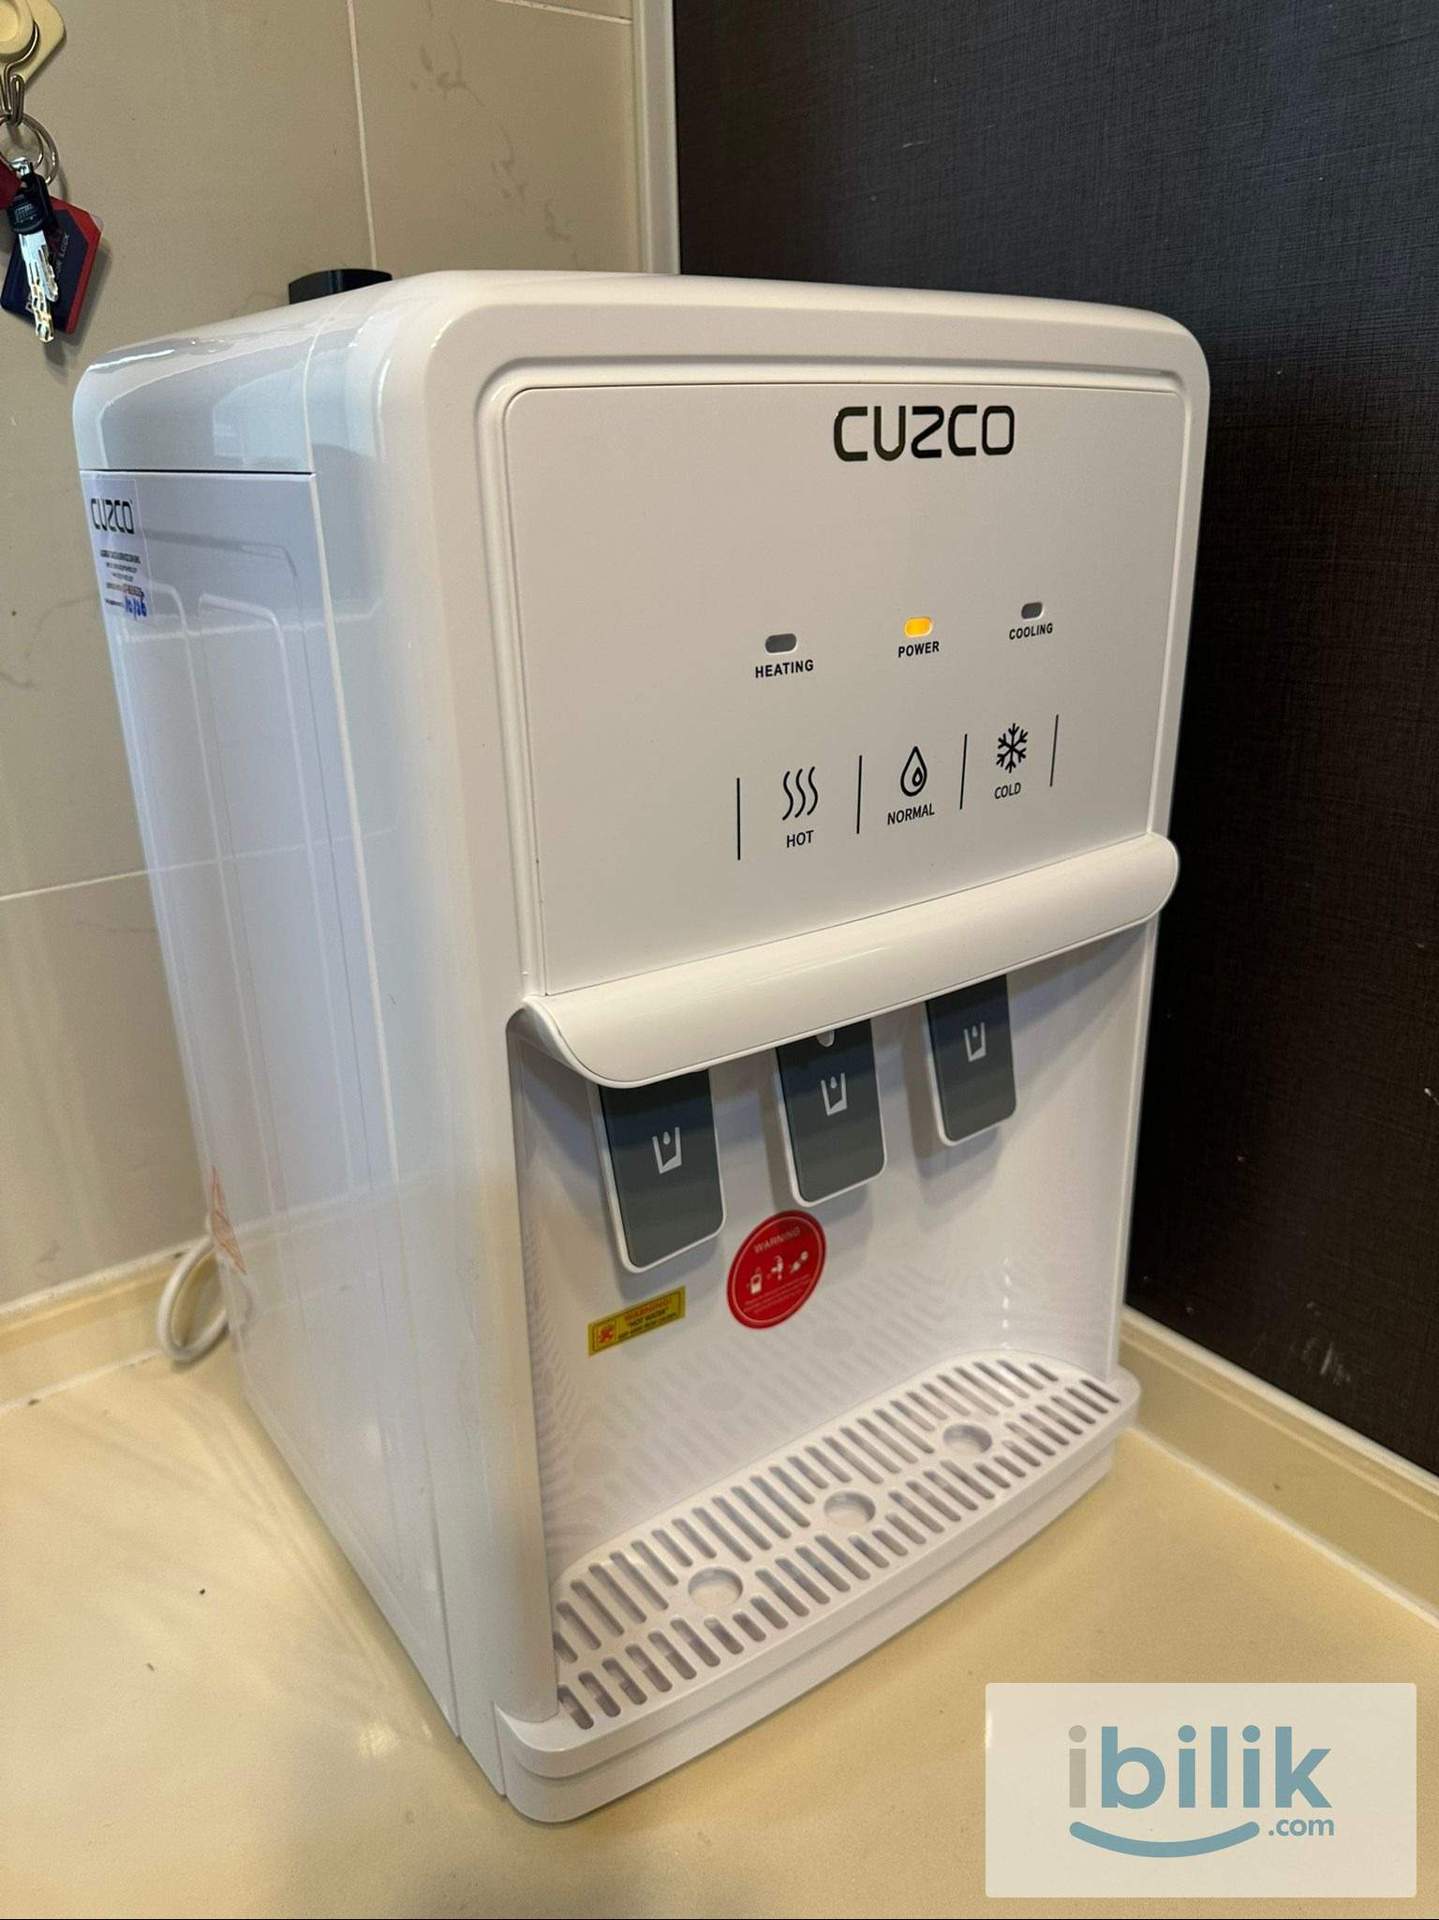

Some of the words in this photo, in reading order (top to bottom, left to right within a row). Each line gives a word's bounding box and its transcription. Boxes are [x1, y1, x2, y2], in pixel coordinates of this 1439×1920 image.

[833, 404, 1015, 462] CUZCO
[91, 498, 135, 535] CUZCO
[1009, 623, 1053, 640] COOLING
[898, 641, 940, 658] POWER
[755, 659, 814, 678] HEATING
[994, 782, 1021, 799] COLD
[887, 803, 935, 825] NORMAL
[786, 830, 814, 848] HOT
